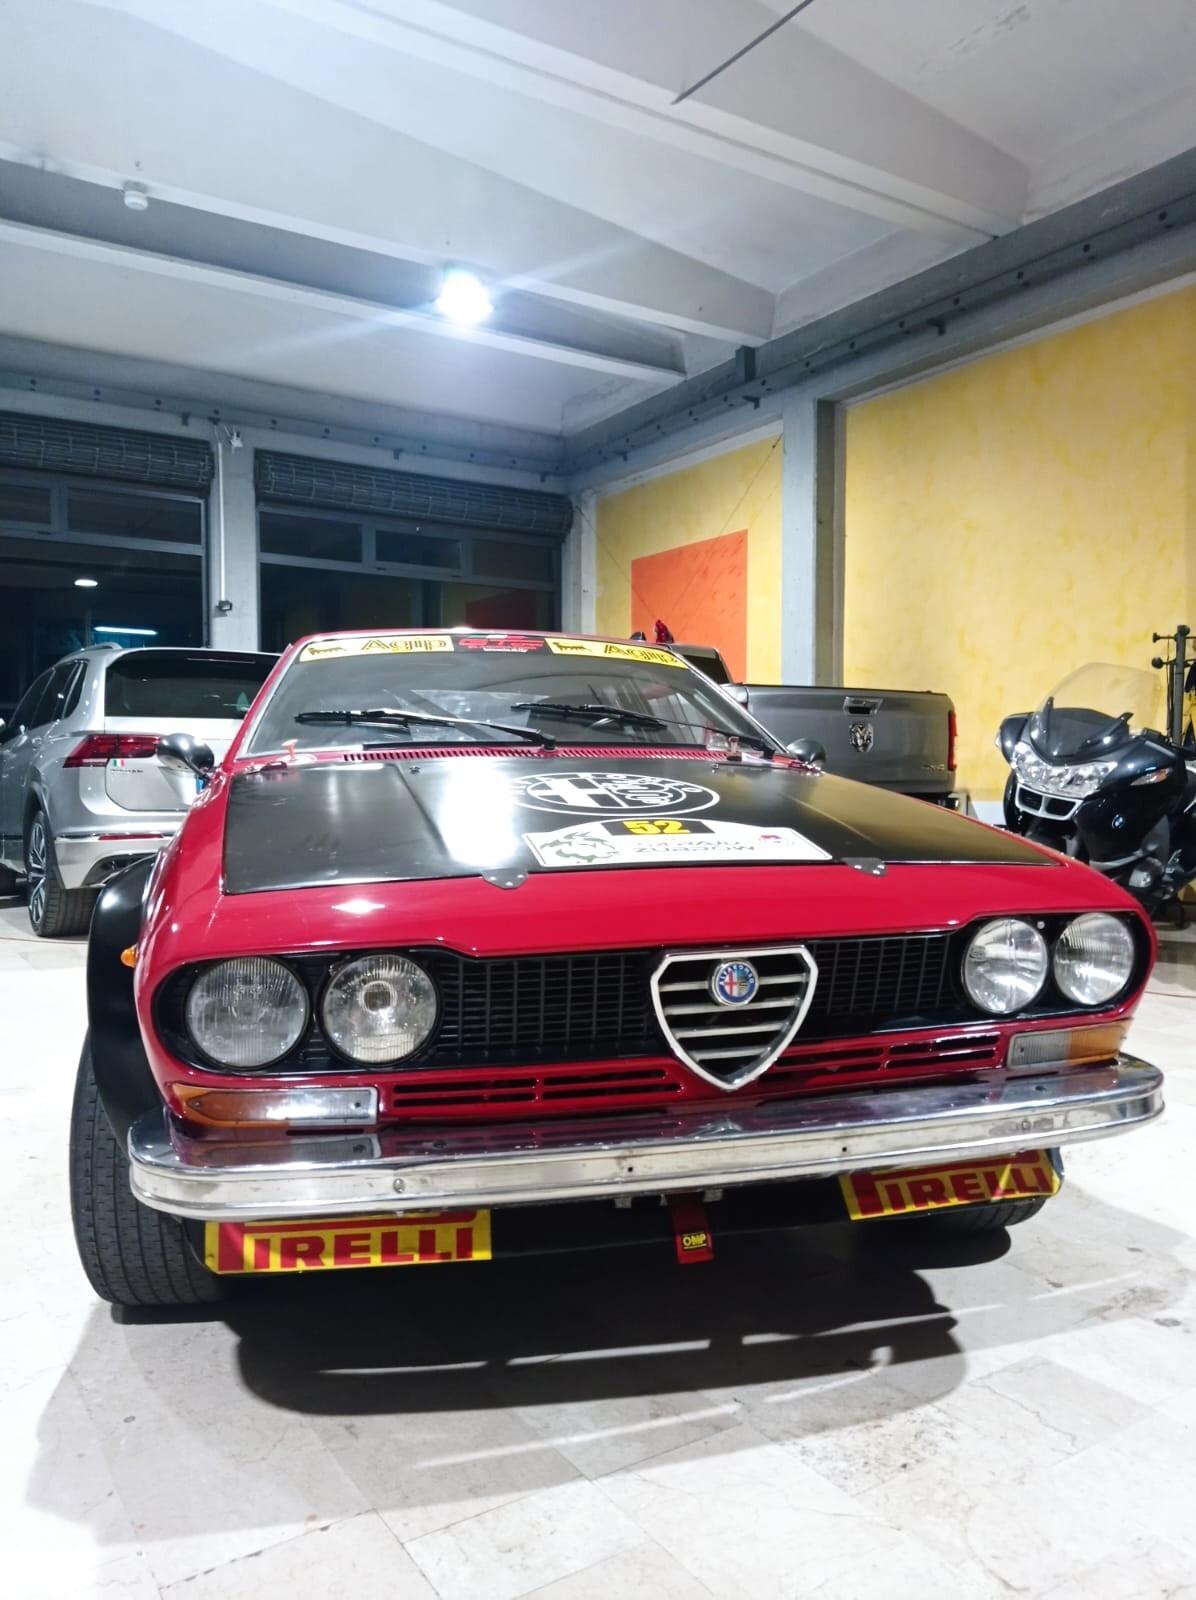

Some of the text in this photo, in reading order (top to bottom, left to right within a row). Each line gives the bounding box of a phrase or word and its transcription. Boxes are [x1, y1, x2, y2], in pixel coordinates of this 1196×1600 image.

[361, 638, 447, 652] Agip
[603, 644, 678, 664] Agip
[623, 818, 691, 835] 52
[850, 1150, 1055, 1216] PIRELLI
[218, 1209, 477, 1271] PIRELLI
[683, 1233, 706, 1246] OMP
